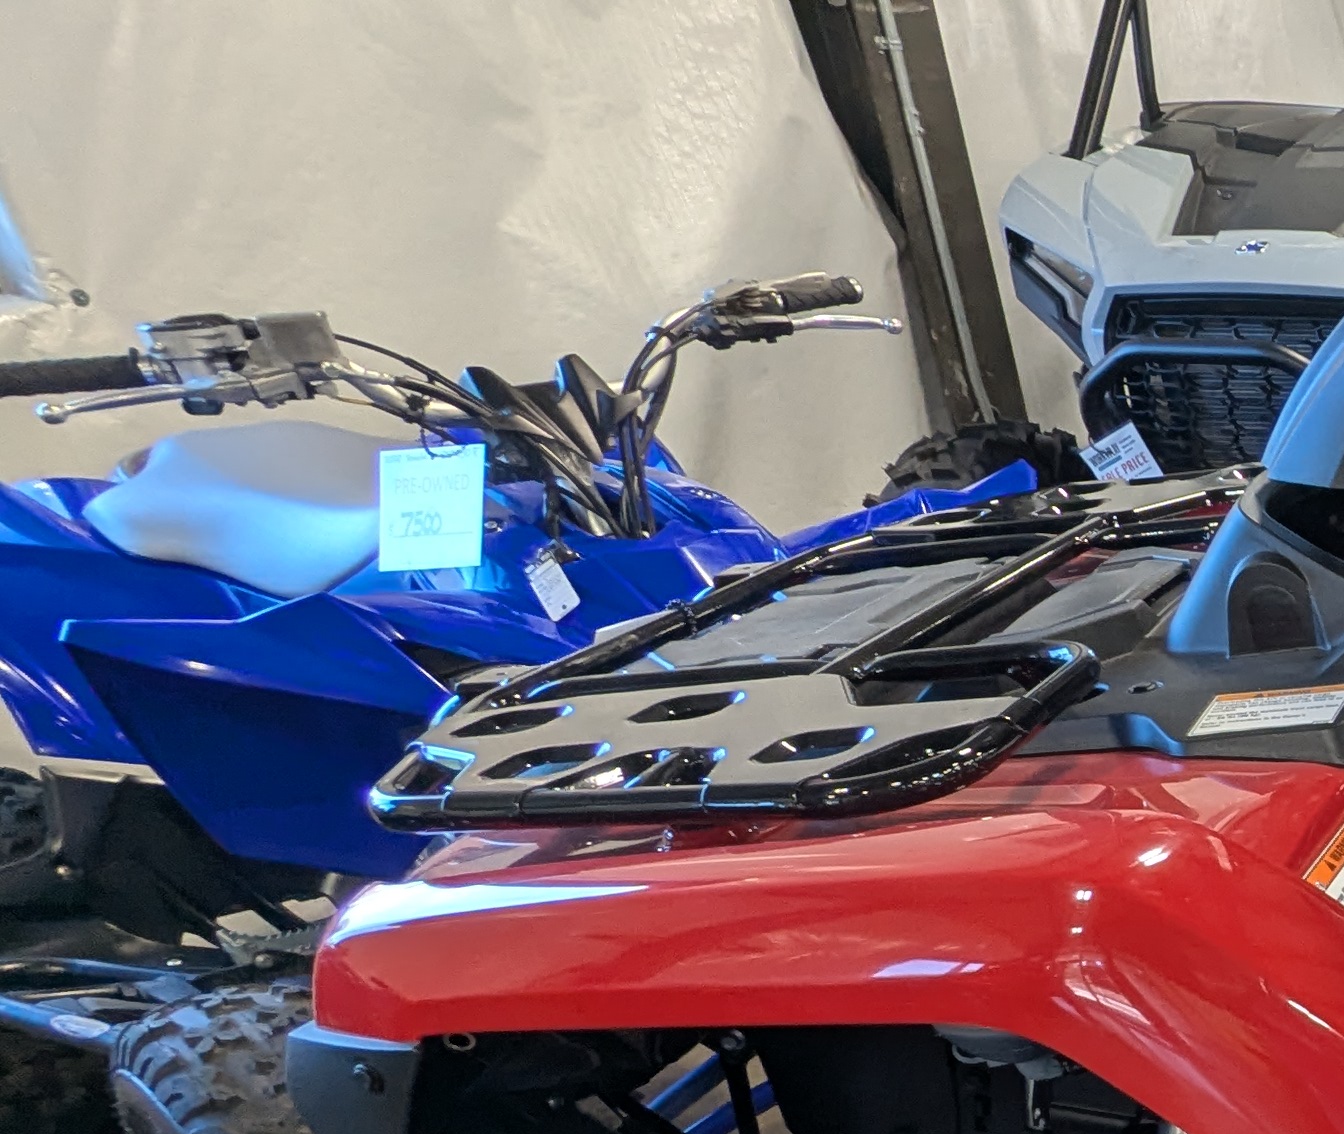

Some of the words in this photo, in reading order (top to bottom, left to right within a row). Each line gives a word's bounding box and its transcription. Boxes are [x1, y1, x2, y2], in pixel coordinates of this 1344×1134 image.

[1121, 452, 1149, 474] PRICE
[394, 473, 470, 495] PRE-OWNED
[400, 510, 442, 538] 7500
